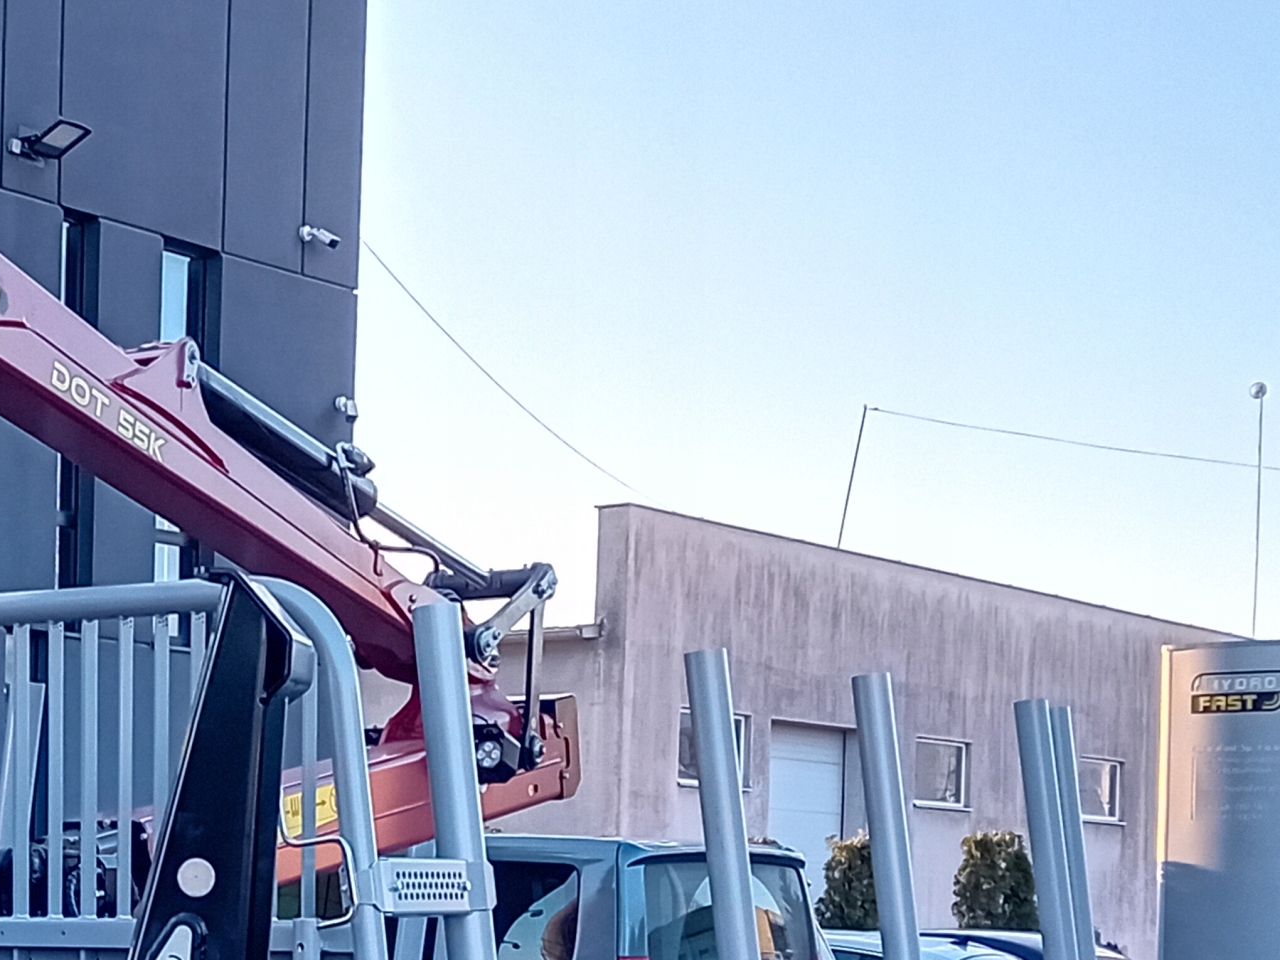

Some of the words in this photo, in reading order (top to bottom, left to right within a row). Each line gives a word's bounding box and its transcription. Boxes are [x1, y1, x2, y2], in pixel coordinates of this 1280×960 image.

[51, 360, 110, 418] DOT
[117, 408, 166, 463] 55K
[1198, 694, 1258, 712] FAST
